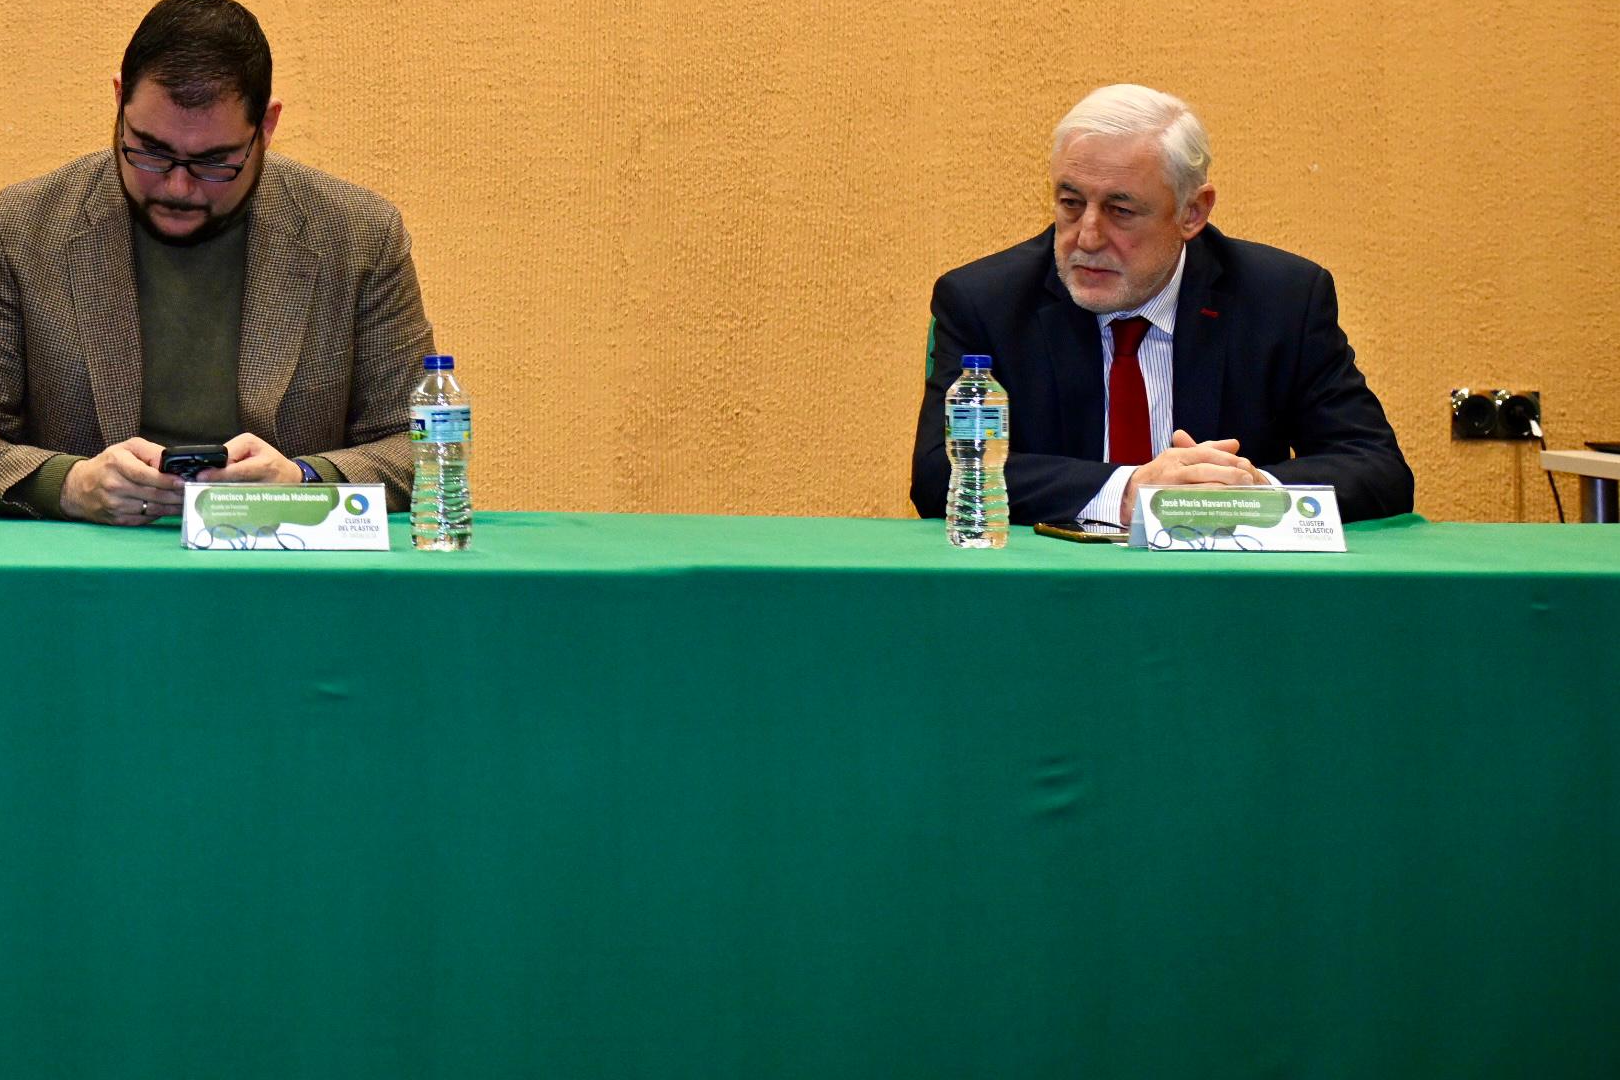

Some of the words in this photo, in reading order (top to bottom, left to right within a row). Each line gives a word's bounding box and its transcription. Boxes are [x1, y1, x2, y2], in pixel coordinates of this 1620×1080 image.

[210, 493, 244, 502] Francisco
[245, 493, 261, 502] José
[261, 493, 290, 502] Miranda
[291, 493, 328, 502] Maldonado
[1160, 498, 1178, 507] José
[1179, 499, 1201, 507] María
[1201, 499, 1231, 508] Navarro
[1232, 499, 1261, 508] Polonio
